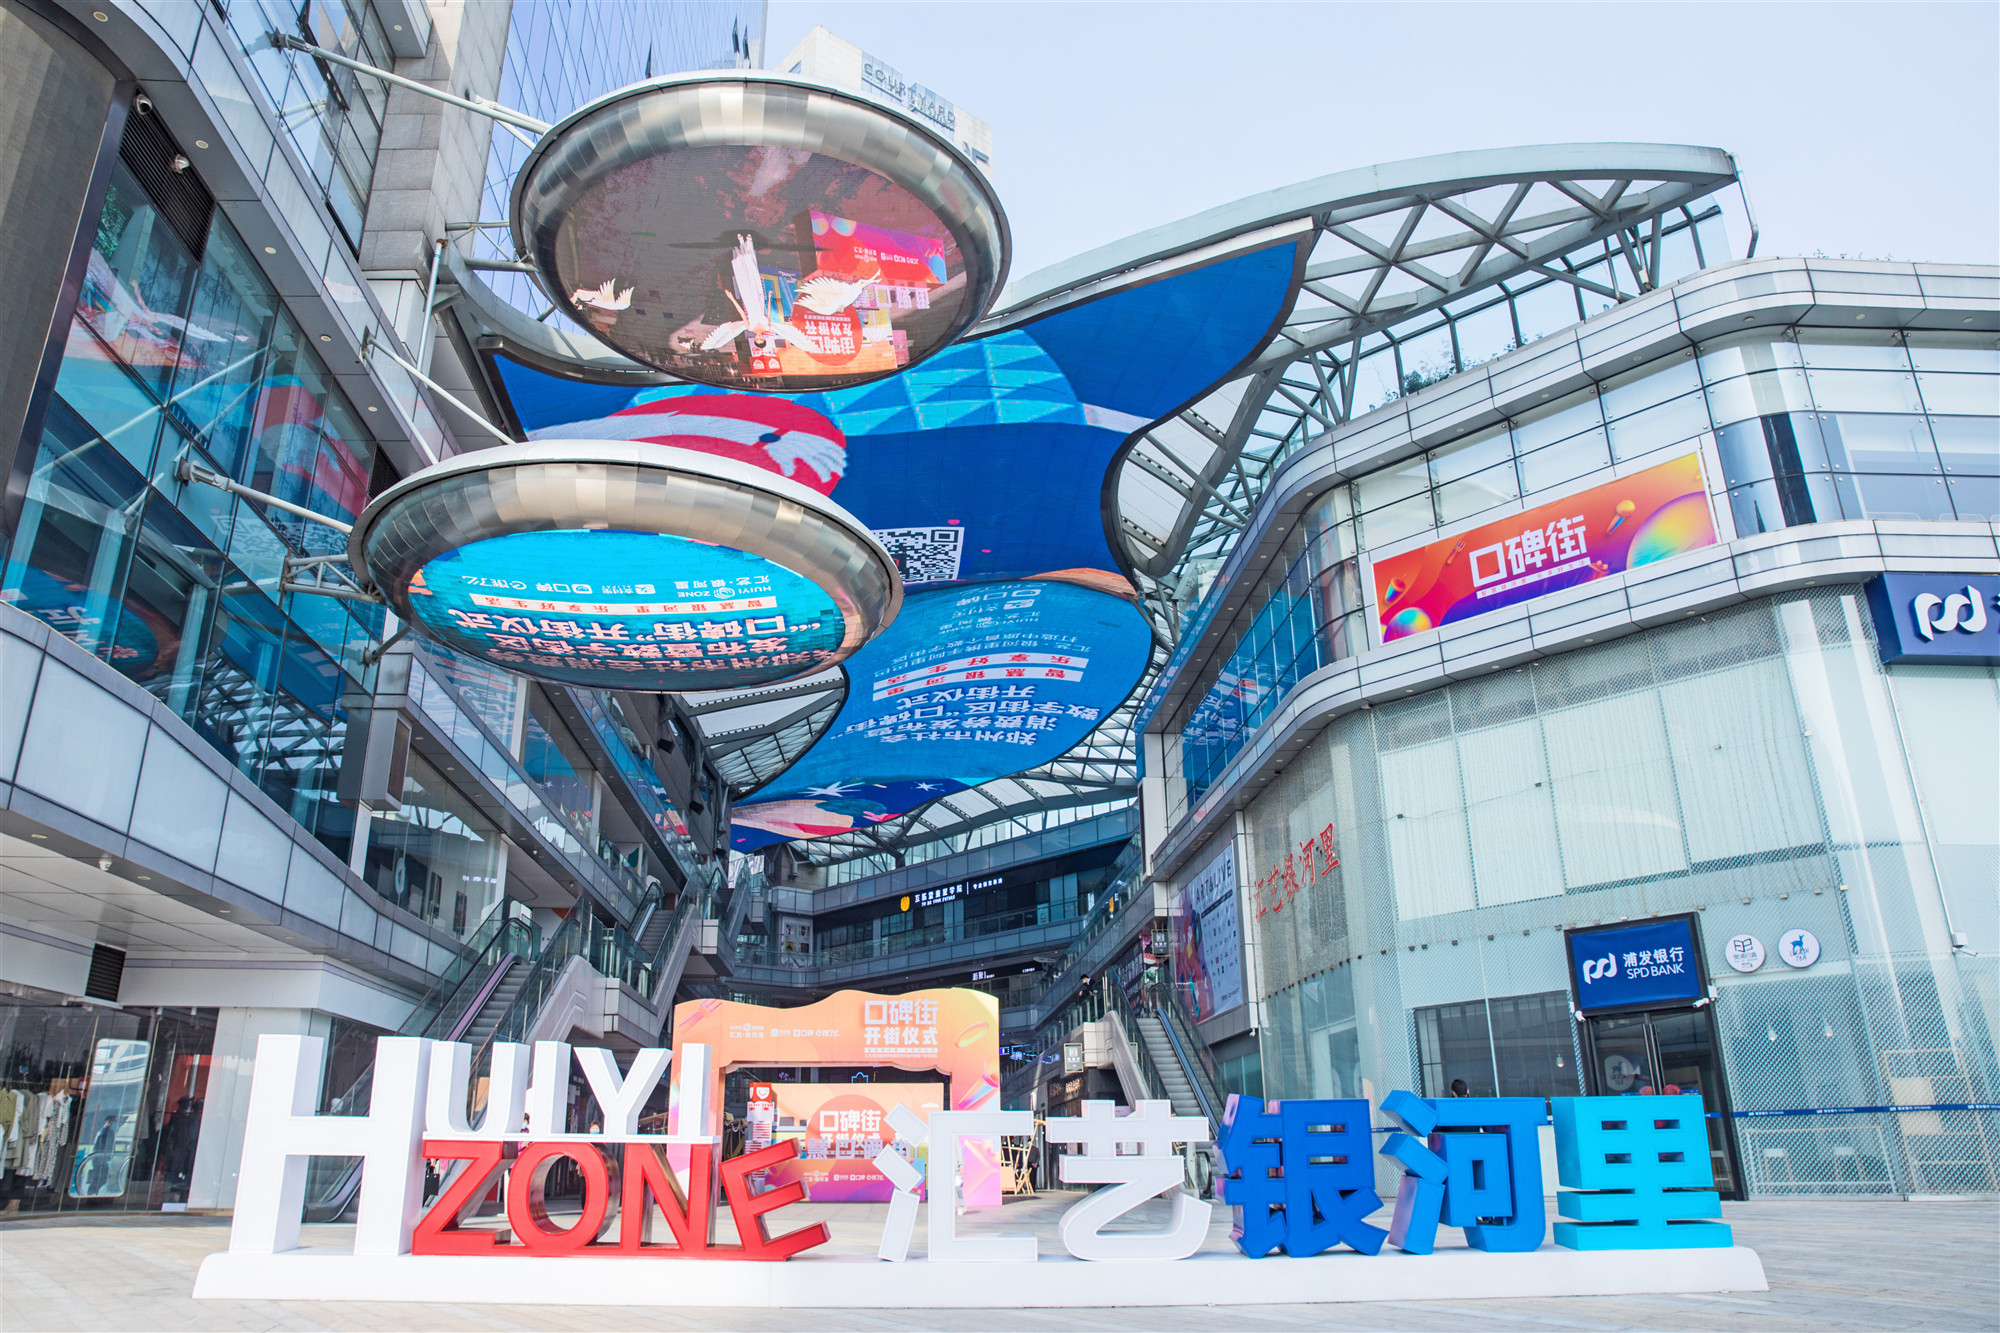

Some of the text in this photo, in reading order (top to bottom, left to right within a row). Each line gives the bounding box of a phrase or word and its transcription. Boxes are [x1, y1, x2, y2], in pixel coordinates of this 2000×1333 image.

[863, 62, 956, 125] COURTYARD
[1468, 514, 1588, 588] 口碑街
[535, 582, 571, 593] 口碑
[677, 585, 771, 598] HUIYI ZONE
[895, 685, 1036, 710] 开街仪式
[863, 715, 1059, 739] 消费券发布暨
[879, 730, 1037, 746] 郑州市社会
[1622, 945, 1684, 967] 浦发银行
[1627, 963, 1684, 979] SPD BANK
[864, 998, 939, 1026] 口碑街
[864, 1027, 939, 1046] 开街仪式
[819, 1109, 881, 1132] 口碑街
[228, 1033, 712, 1255] HUIYI
[873, 1089, 1735, 1262] 汇艺银河里
[412, 1137, 832, 1260] ZONE
